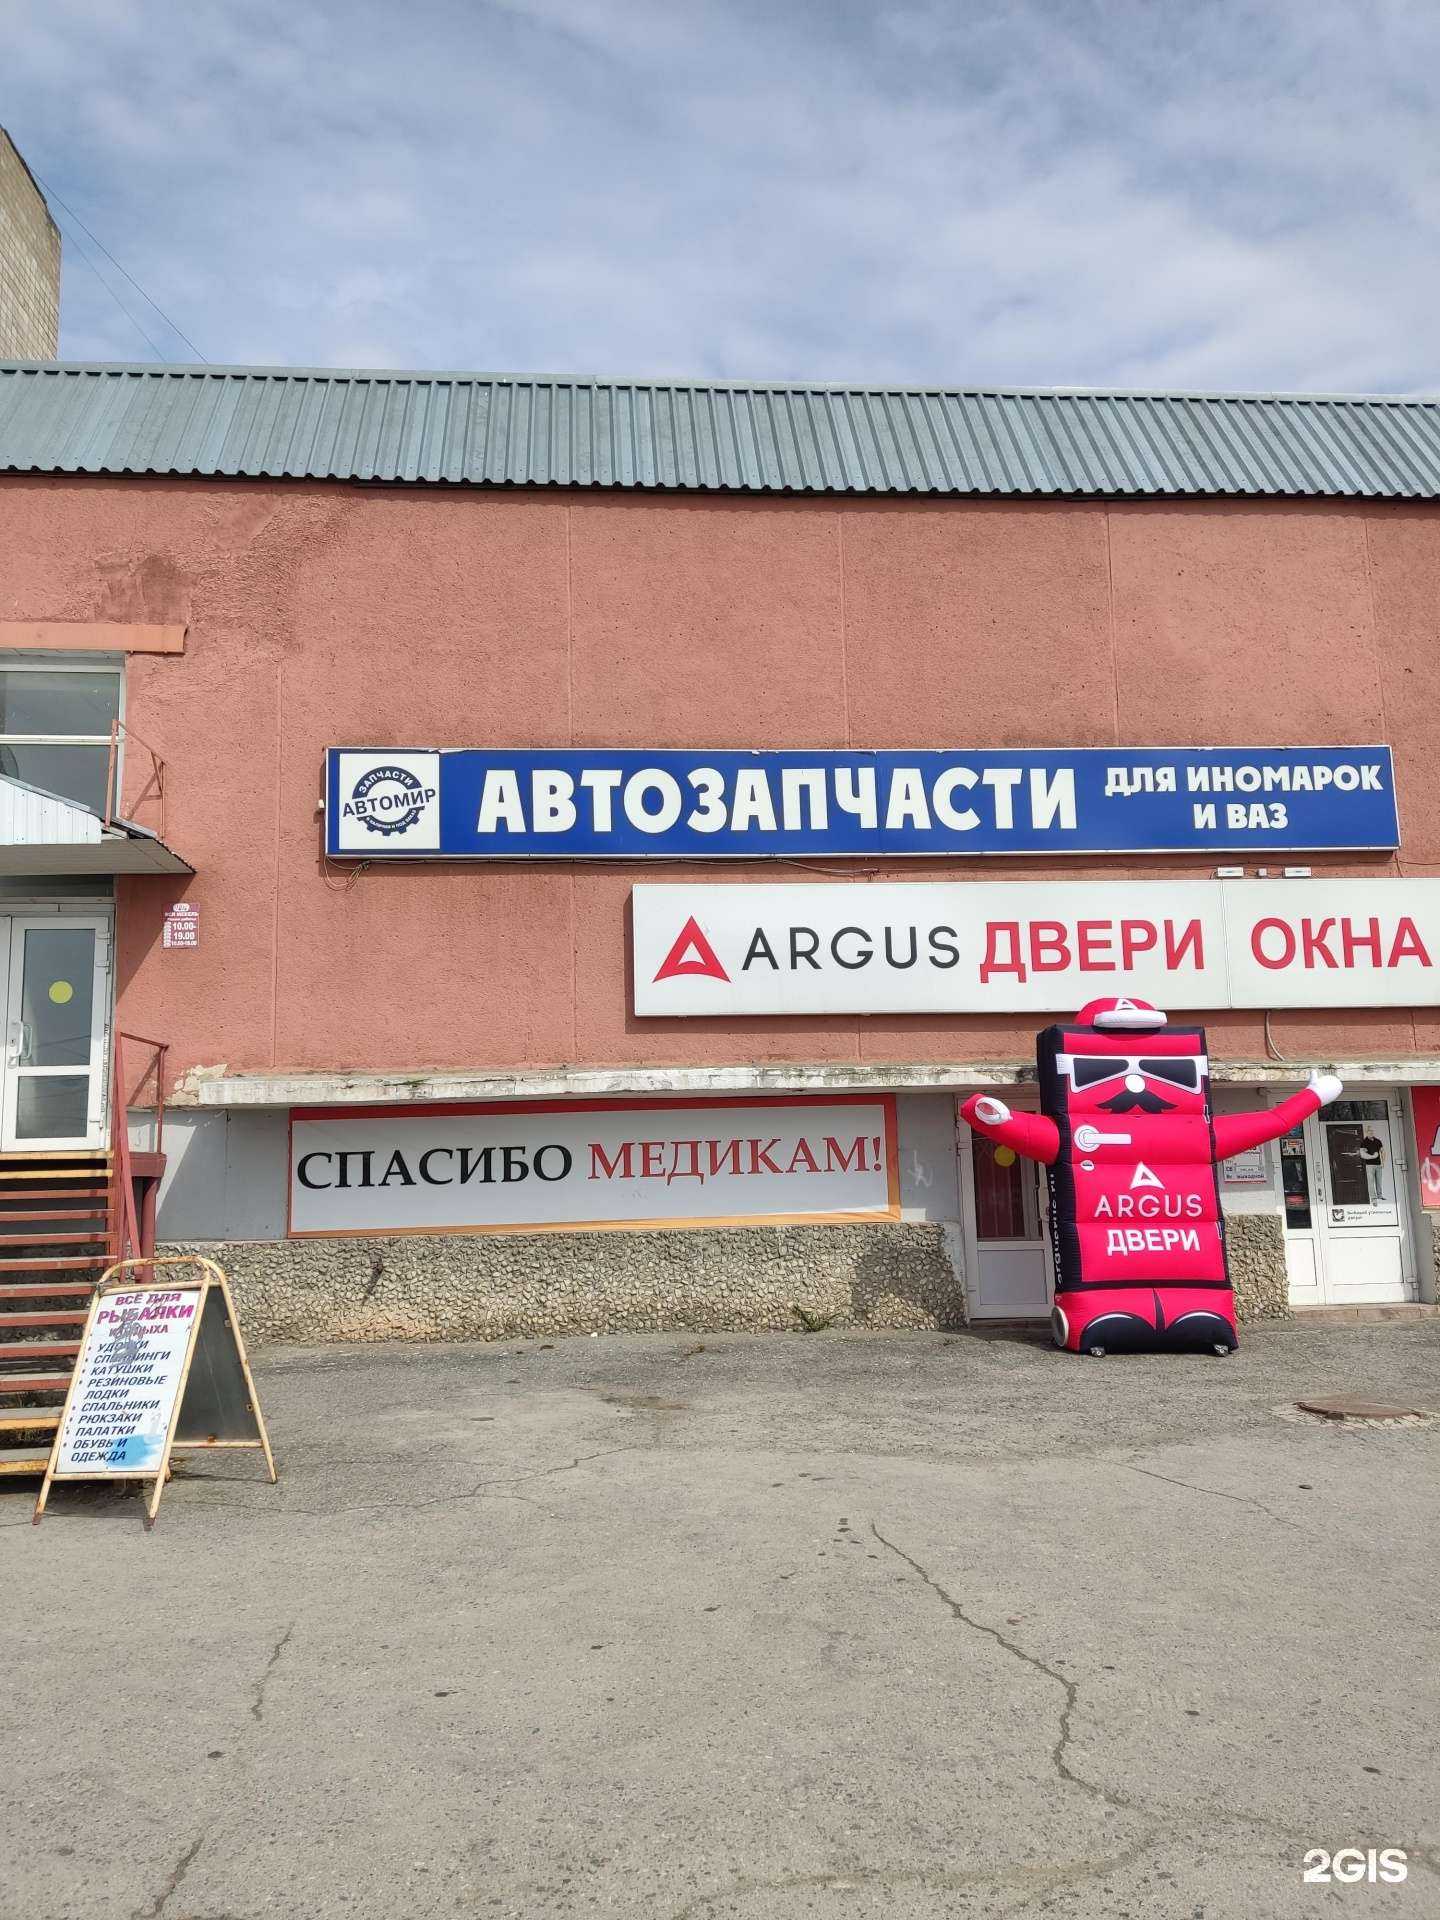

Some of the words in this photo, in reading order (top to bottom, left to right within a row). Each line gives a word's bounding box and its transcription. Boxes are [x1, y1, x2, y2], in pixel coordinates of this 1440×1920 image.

[359, 770, 414, 793] ЗАПЧАСТИ
[1105, 766, 1176, 797] ДЛЯ
[1191, 764, 1384, 794] ИНОМАРОК
[343, 788, 436, 817] АВТОМИР
[477, 767, 1077, 834] АВТОЗАПЧАСТИ
[1194, 803, 1216, 829] И
[1227, 802, 1289, 829] ВАЗ
[174, 932, 195, 940] 19.00
[742, 926, 960, 970] ARGUS
[980, 919, 1204, 983] ДВЕРИ
[1251, 917, 1432, 969] ОКНА
[297, 1145, 573, 1189] СПАСИБО
[588, 1136, 882, 1186] МЕДИКАМ!
[1094, 1194, 1203, 1218] ARGUS
[1107, 1229, 1201, 1256] ДВЕРИ
[115, 1293, 143, 1305] ВСЁ
[146, 1293, 182, 1305] ДЛЯ
[98, 1341, 149, 1353] УДОИ
[94, 1351, 171, 1364] СПИНГИ
[91, 1364, 153, 1375] КАТУШКИ
[88, 1375, 168, 1387] РЕЗИНОВЫЕ
[84, 1389, 130, 1400] ЛОДКИ
[81, 1400, 160, 1412] СПАЛЬНИКИ
[78, 1413, 143, 1424] РЮКЗАКИ
[76, 1426, 136, 1437] ПАЛАТКИ
[73, 1439, 113, 1449] ОБУВЬ
[117, 1438, 128, 1448] И
[71, 1451, 126, 1463] ОДЕЖДА
